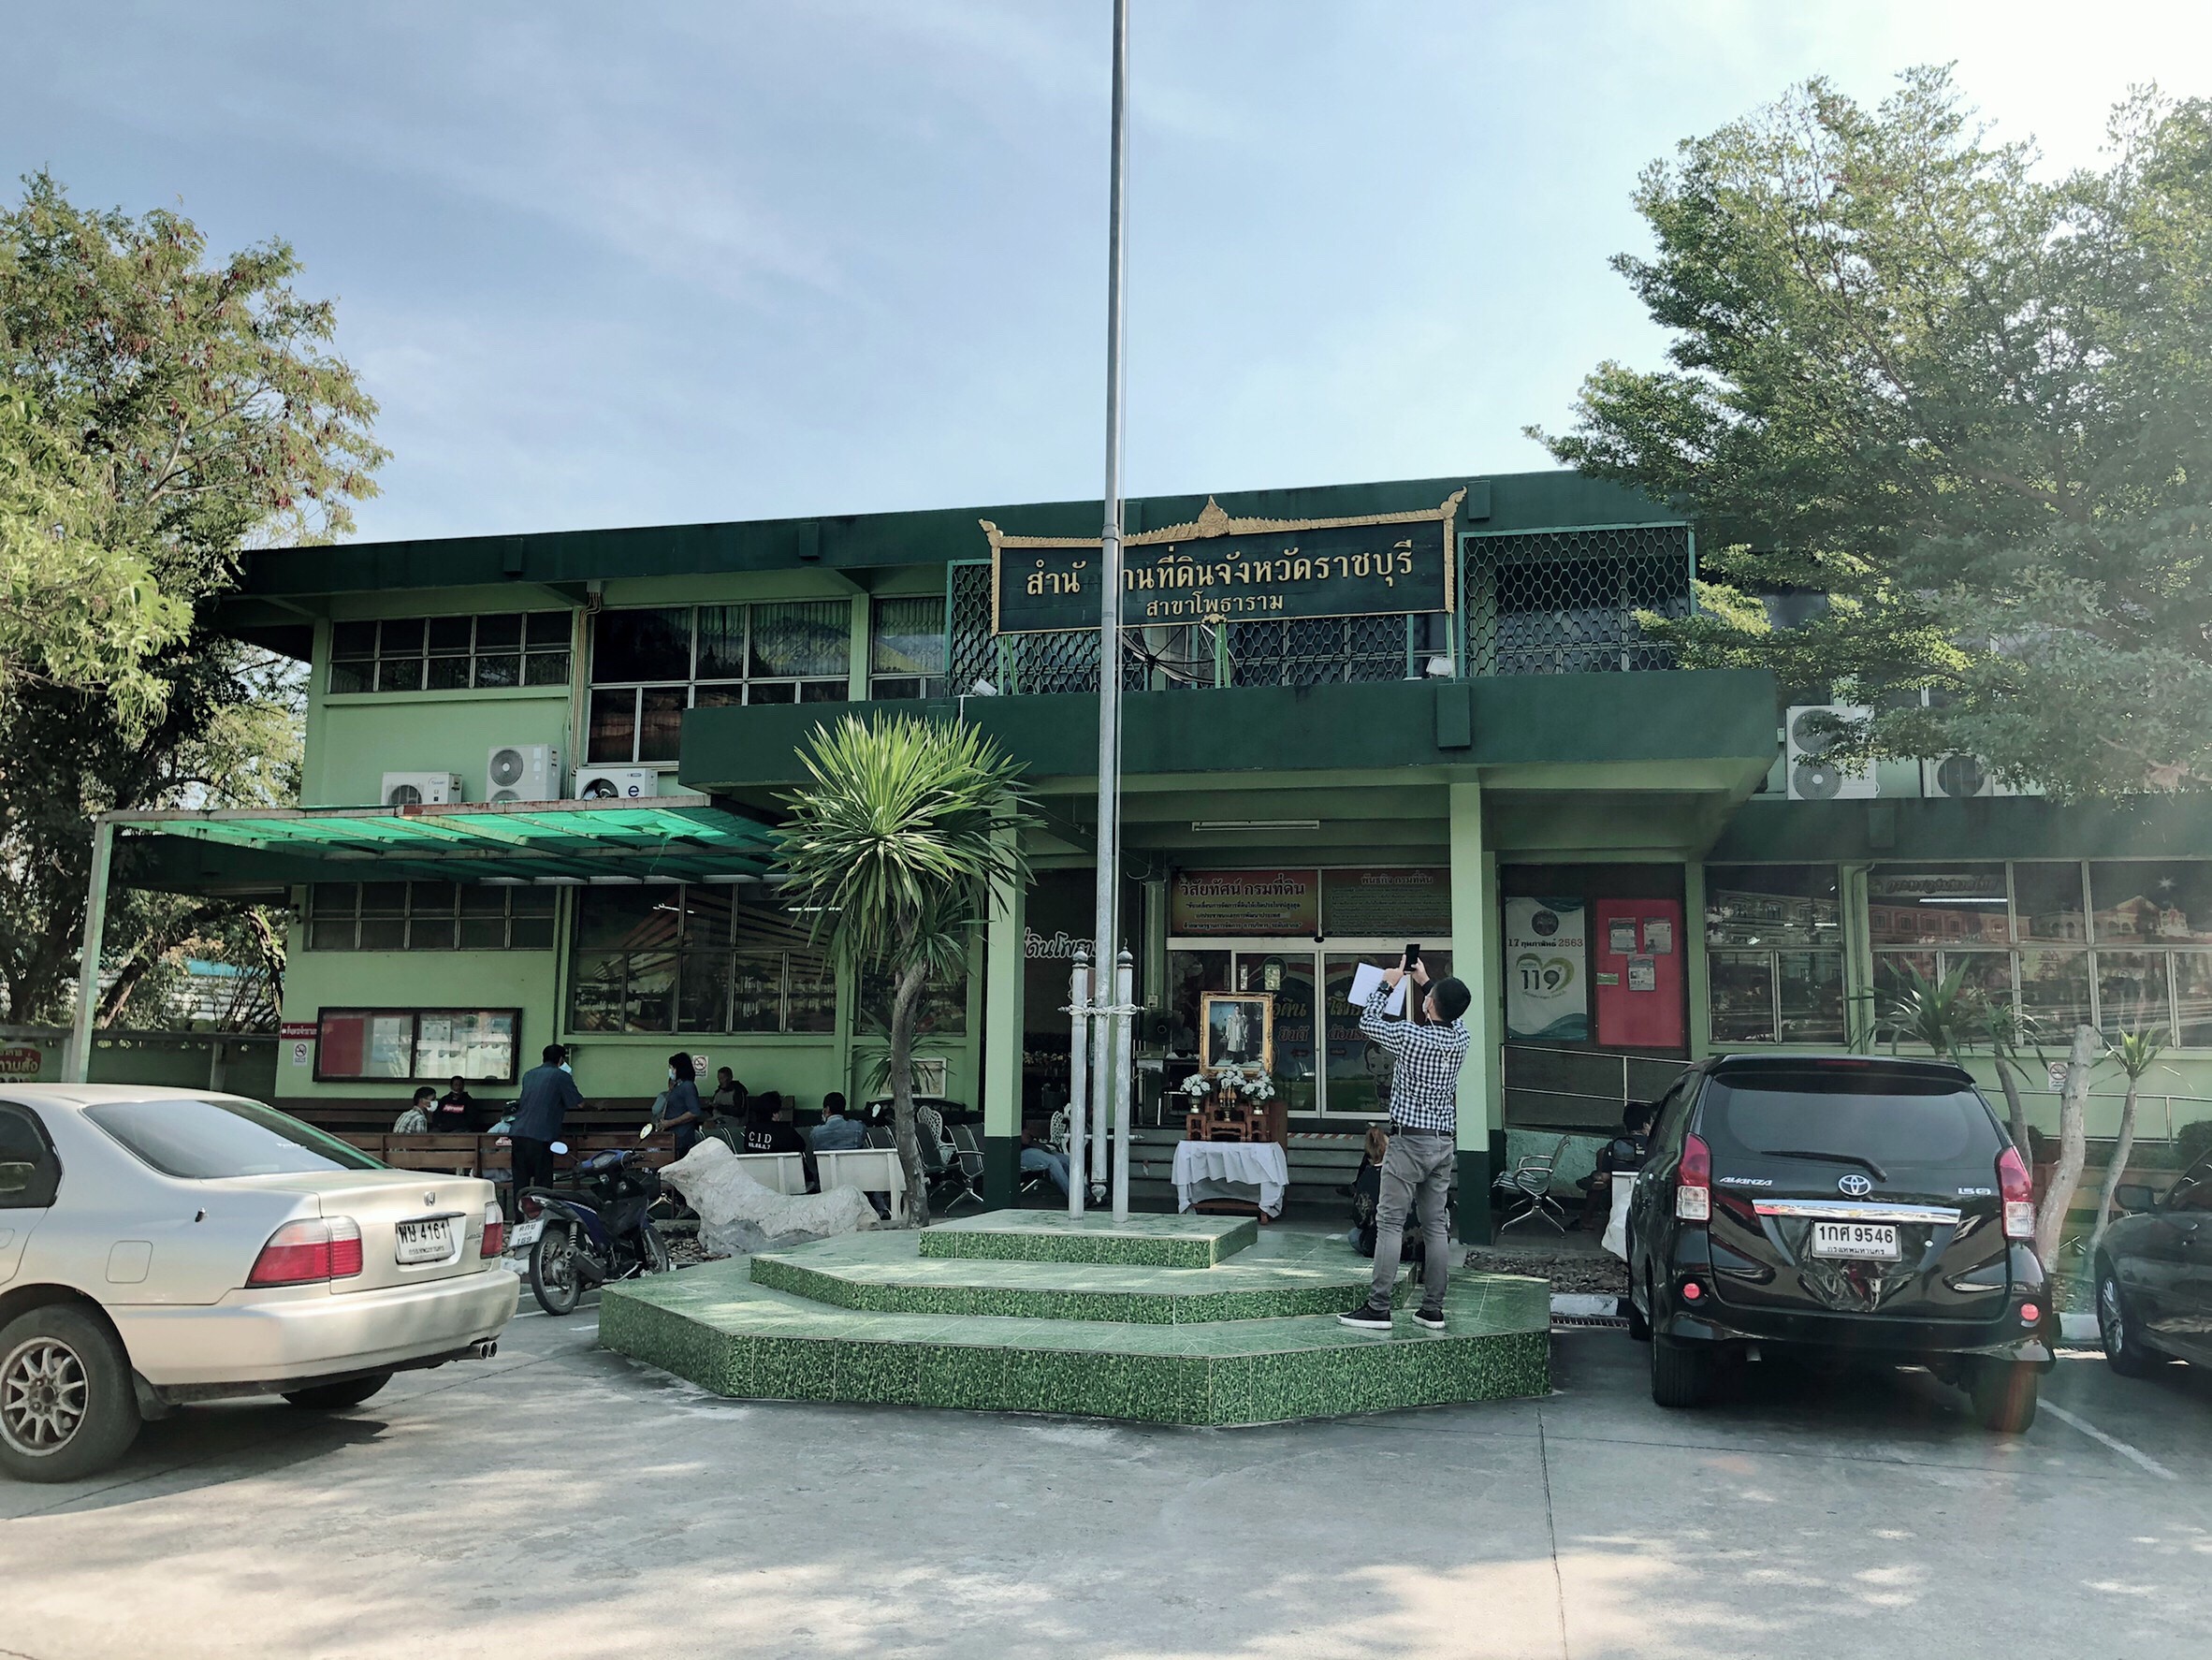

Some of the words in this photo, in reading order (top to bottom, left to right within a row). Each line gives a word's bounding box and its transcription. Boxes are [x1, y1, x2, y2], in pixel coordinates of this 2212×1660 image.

[1026, 539, 1413, 595] สำนัานที่ดินจังหวัดราชบุรี
[1146, 590, 1284, 618] สาขาโพธาราม
[1244, 873, 1306, 896] กรมที่ดิน
[1507, 939, 1520, 947] 17
[1521, 939, 1557, 949] กุมภาพันธ์
[1558, 939, 1583, 947] 2563
[1521, 969, 1561, 990] 119
[1328, 1024, 1370, 1041] ต้อนร
[749, 1131, 772, 1143] CID
[1719, 1176, 1773, 1187] AVANZA
[421, 1221, 447, 1240] 4161
[1819, 1226, 1850, 1242] 1กศ
[1855, 1228, 1893, 1244] 9546
[1827, 1246, 1885, 1255] กรงเทพมหานคร
